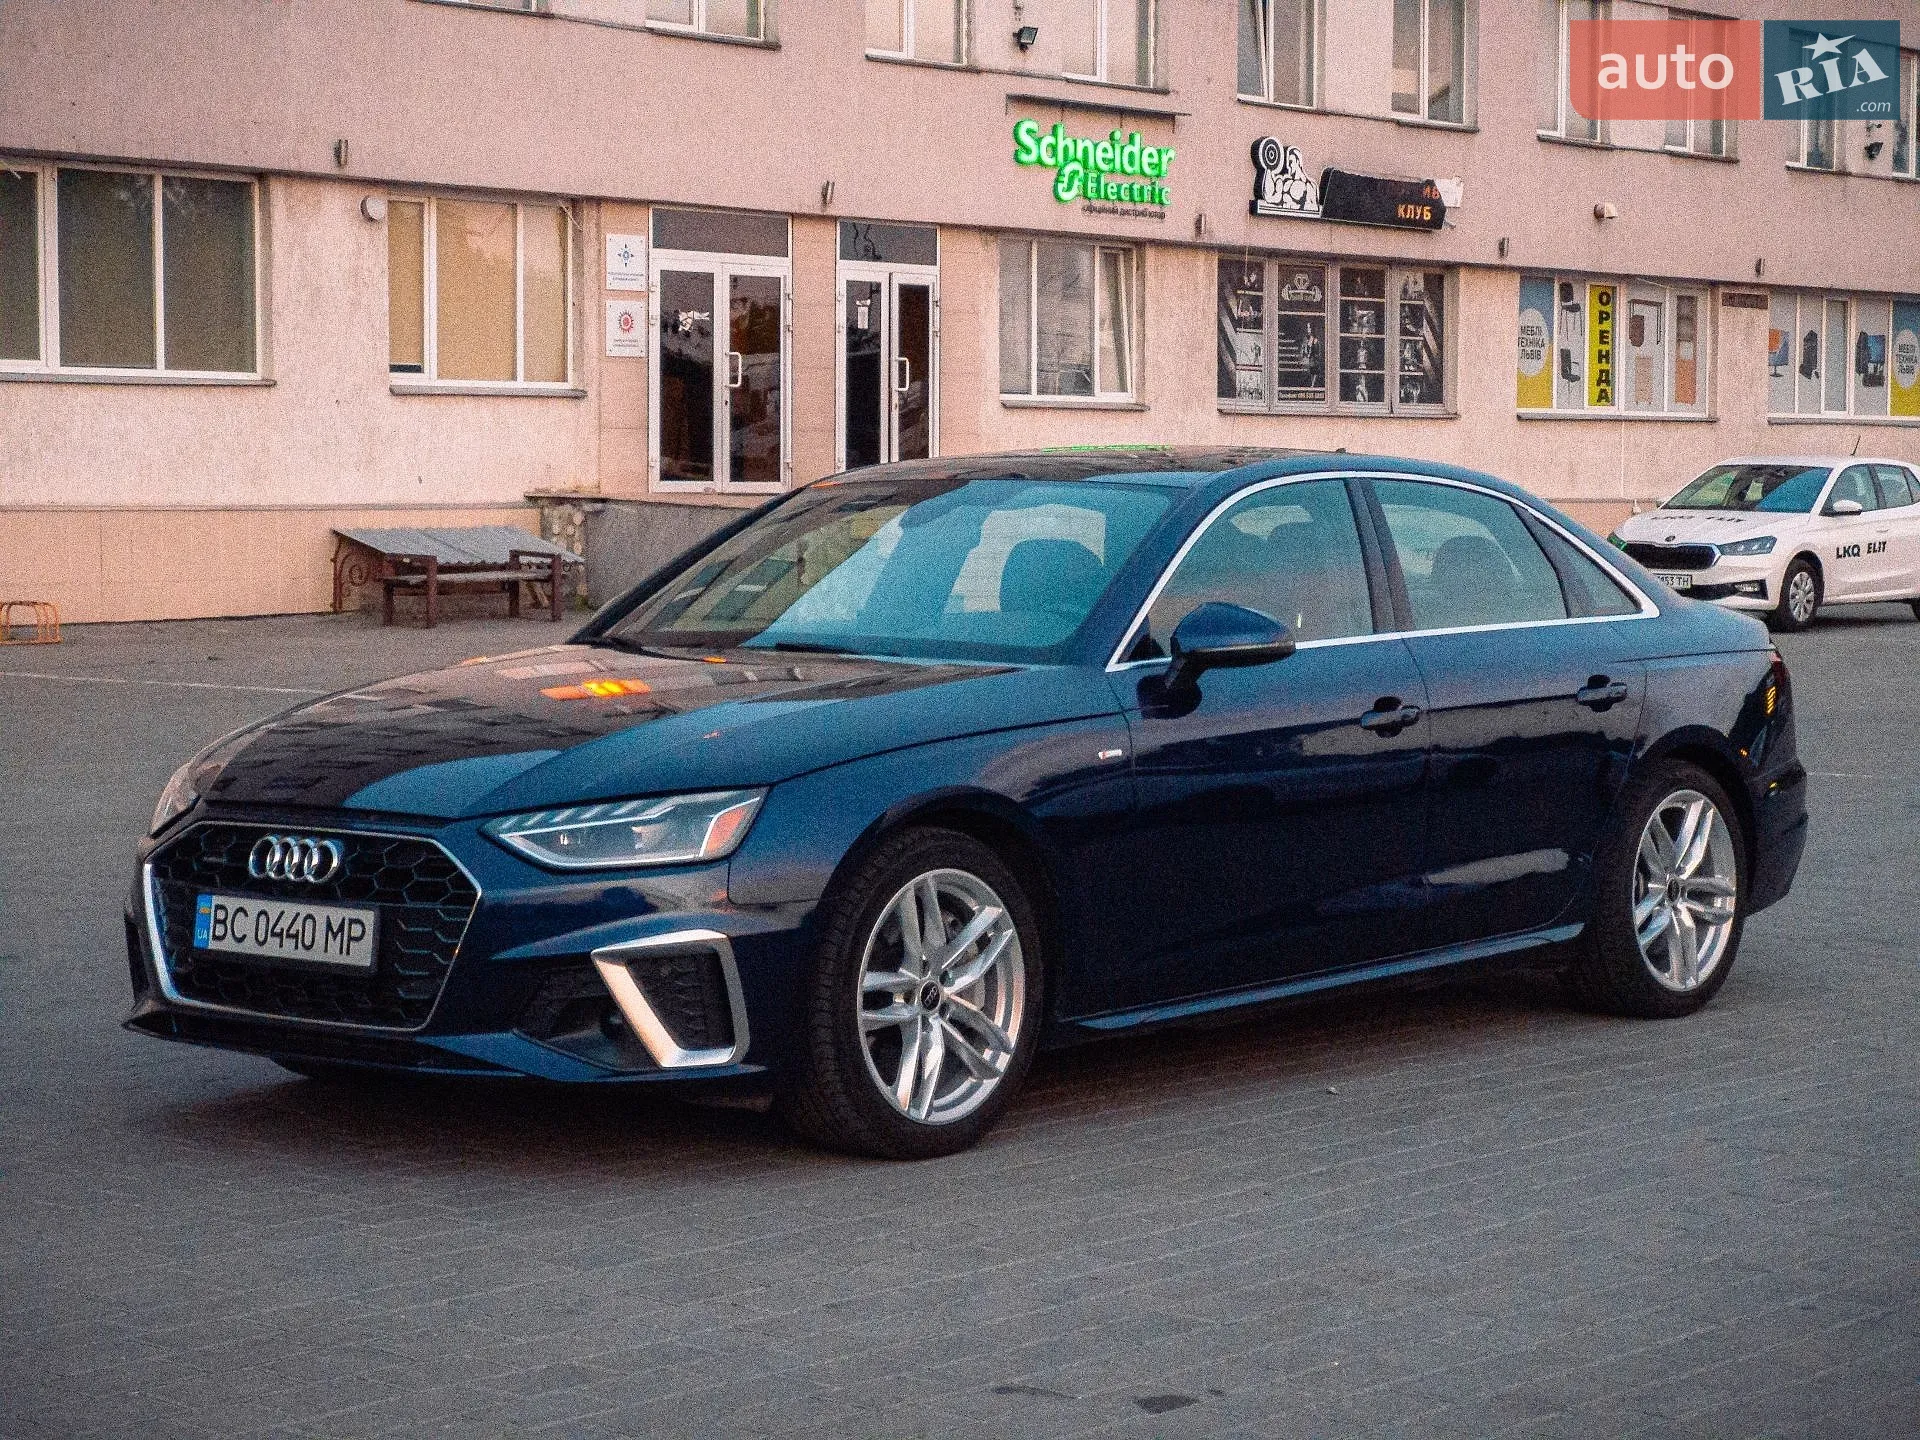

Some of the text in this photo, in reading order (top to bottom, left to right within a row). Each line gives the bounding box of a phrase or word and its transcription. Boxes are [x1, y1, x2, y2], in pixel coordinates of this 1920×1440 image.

[1014, 119, 1175, 178] Schneider
[1085, 170, 1172, 206] Electric
[1397, 204, 1432, 221] КЛУБ
[1597, 291, 1612, 404] ОРЕНДА
[1836, 541, 1887, 559] LKQ ELIT
[1676, 577, 1689, 587] TH
[197, 928, 208, 939] UA
[212, 904, 366, 956] BC 0440 MP
